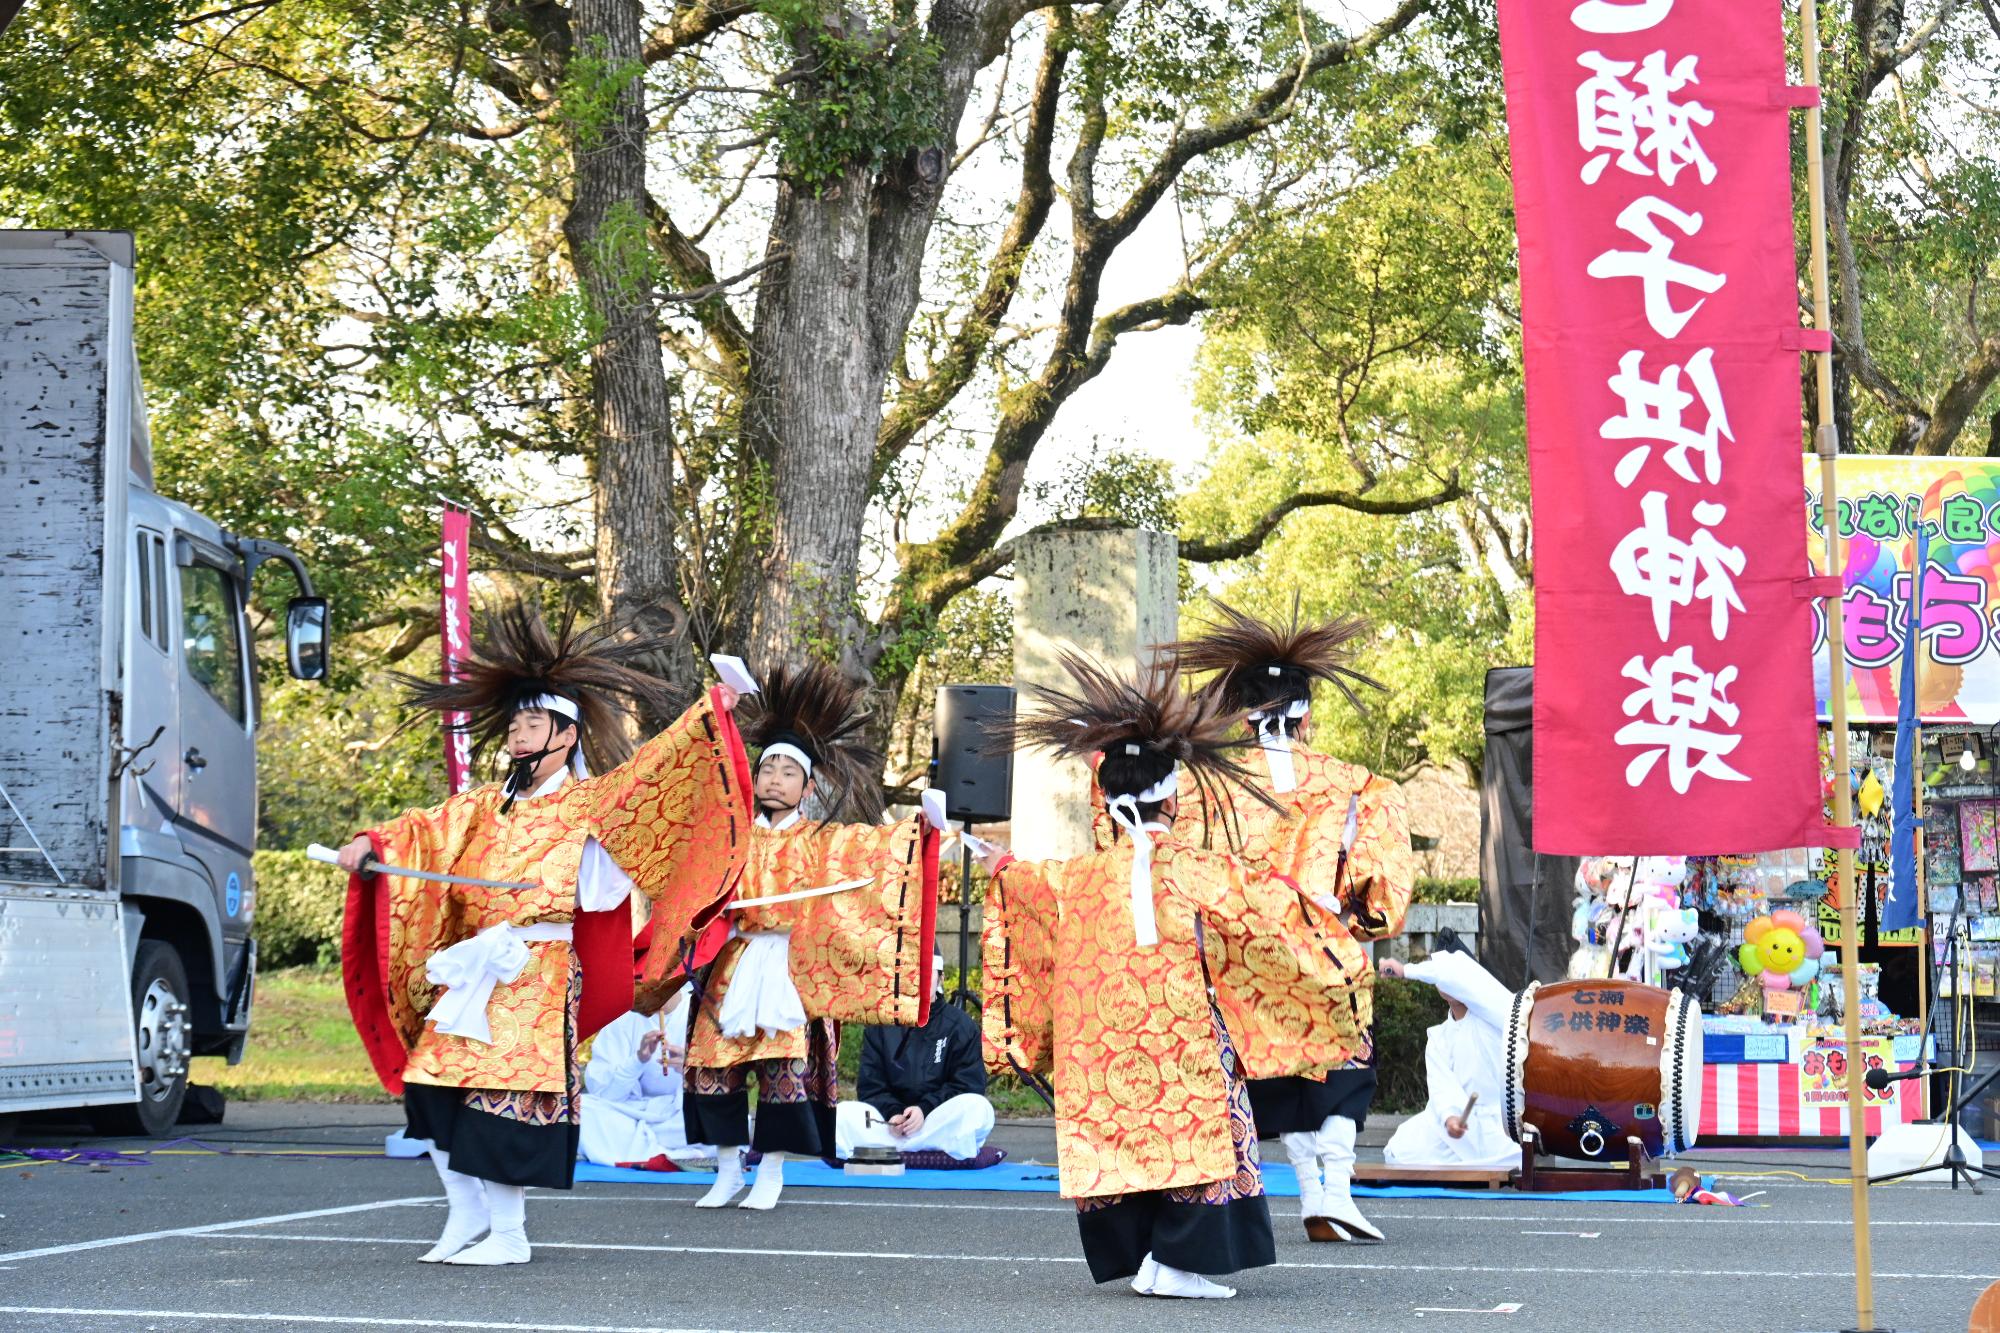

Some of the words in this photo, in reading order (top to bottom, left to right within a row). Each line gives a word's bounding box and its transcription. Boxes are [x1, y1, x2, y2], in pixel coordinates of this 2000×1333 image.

[1804, 491, 2000, 544] れなし良
[1808, 559, 2000, 665] もち
[1543, 1010, 1650, 1035] 子供神楽
[1803, 1050, 1883, 1076] おもゃ
[1803, 1091, 1849, 1102] 1回400
